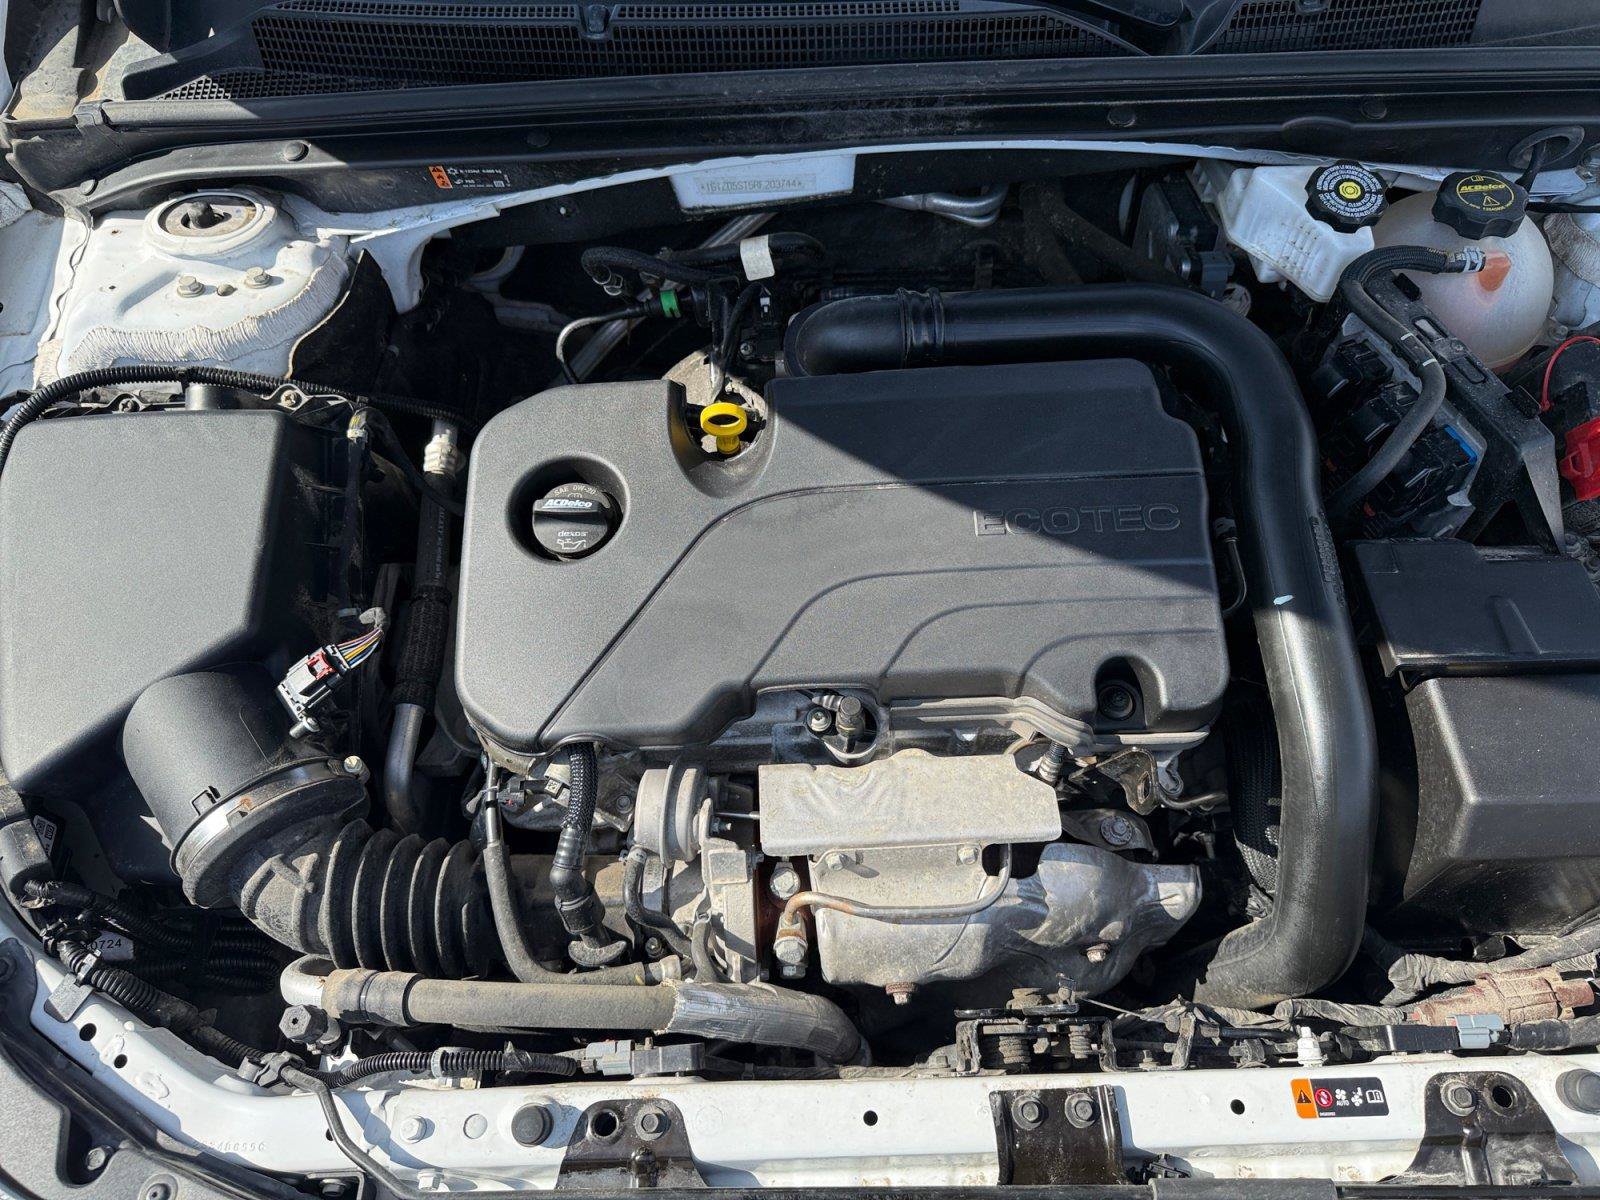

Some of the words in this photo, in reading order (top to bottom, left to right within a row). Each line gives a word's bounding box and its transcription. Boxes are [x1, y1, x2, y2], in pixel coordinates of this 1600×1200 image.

[1460, 183, 1506, 193] ACDelco
[554, 487, 570, 496] SAE
[572, 485, 597, 495] 0W-20
[542, 498, 592, 508] ACDelco
[973, 503, 1181, 536] ECOTEC
